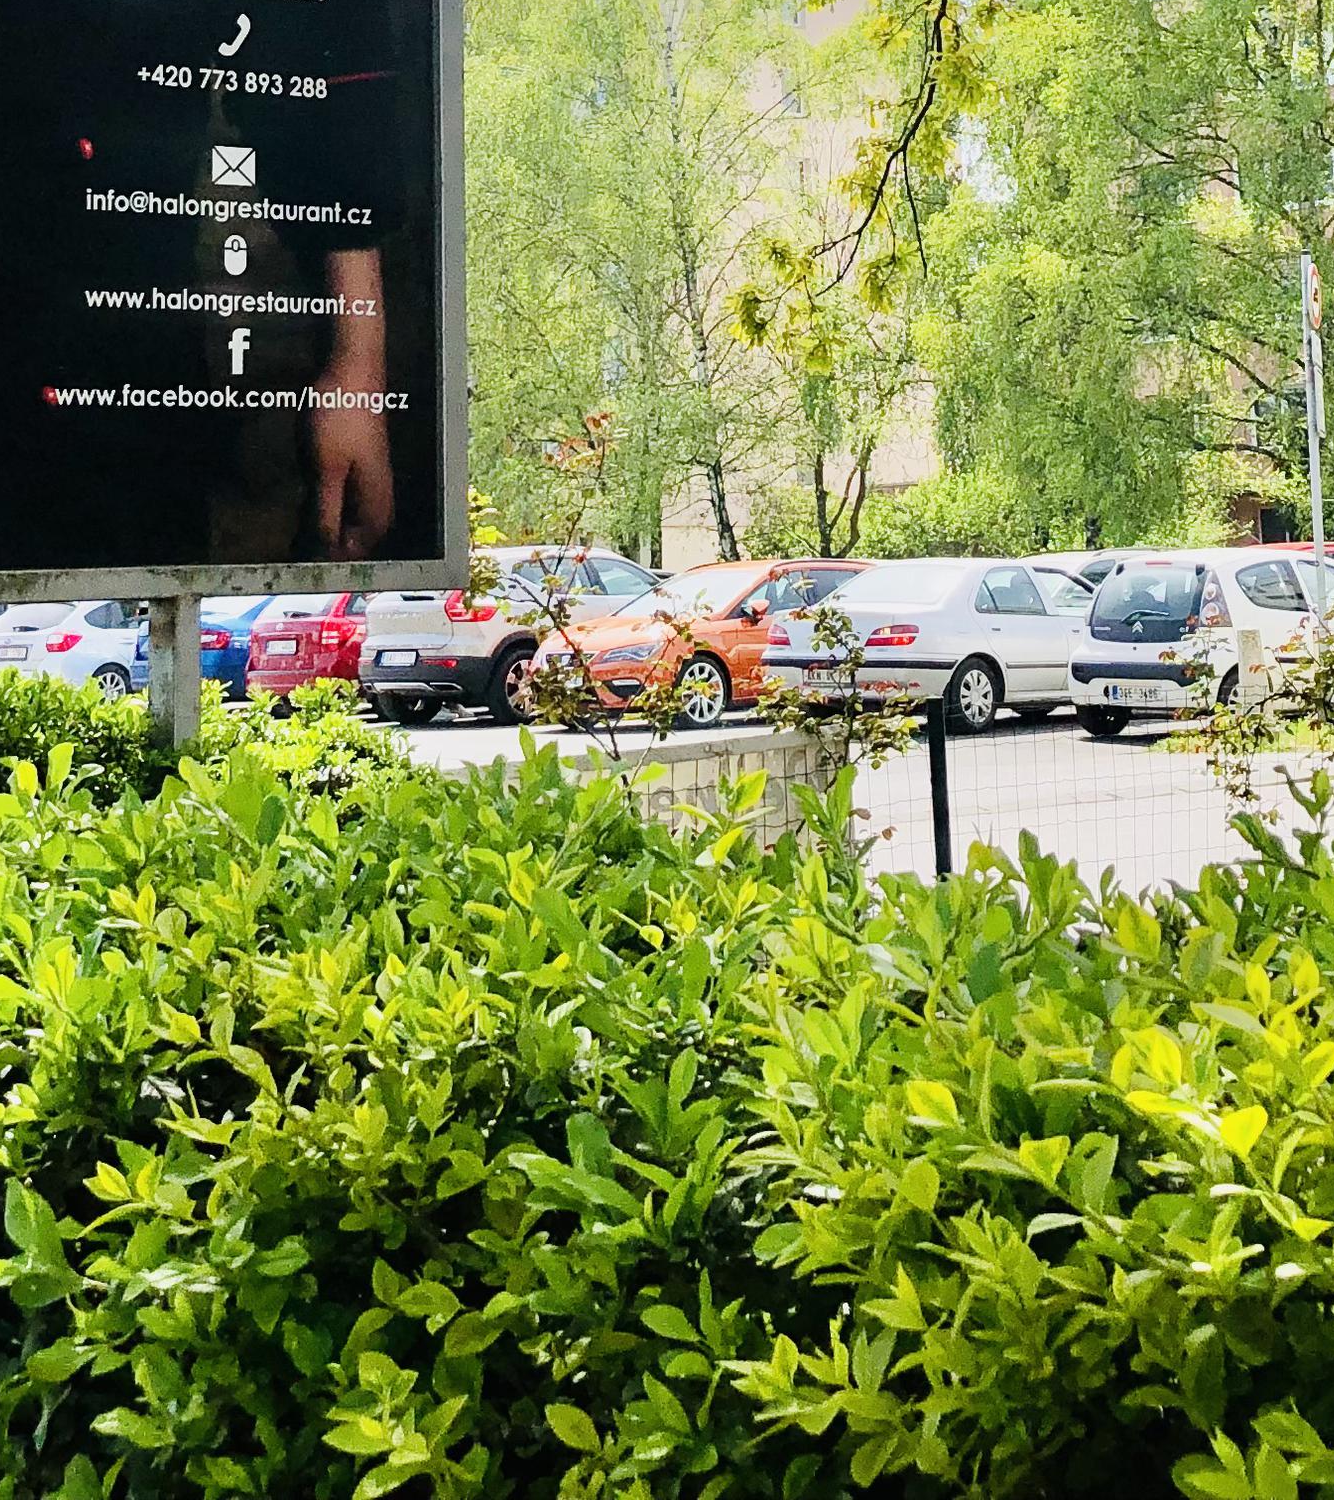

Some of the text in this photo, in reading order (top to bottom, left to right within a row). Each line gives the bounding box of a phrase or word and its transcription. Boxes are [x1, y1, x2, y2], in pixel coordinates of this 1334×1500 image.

[137, 64, 328, 99] +420 773 893 288
[86, 188, 372, 225] info@halongrestaurant.cz
[84, 287, 377, 317] www.halongrestaurant.cz
[54, 383, 409, 414] www.facebook.com/halongcz
